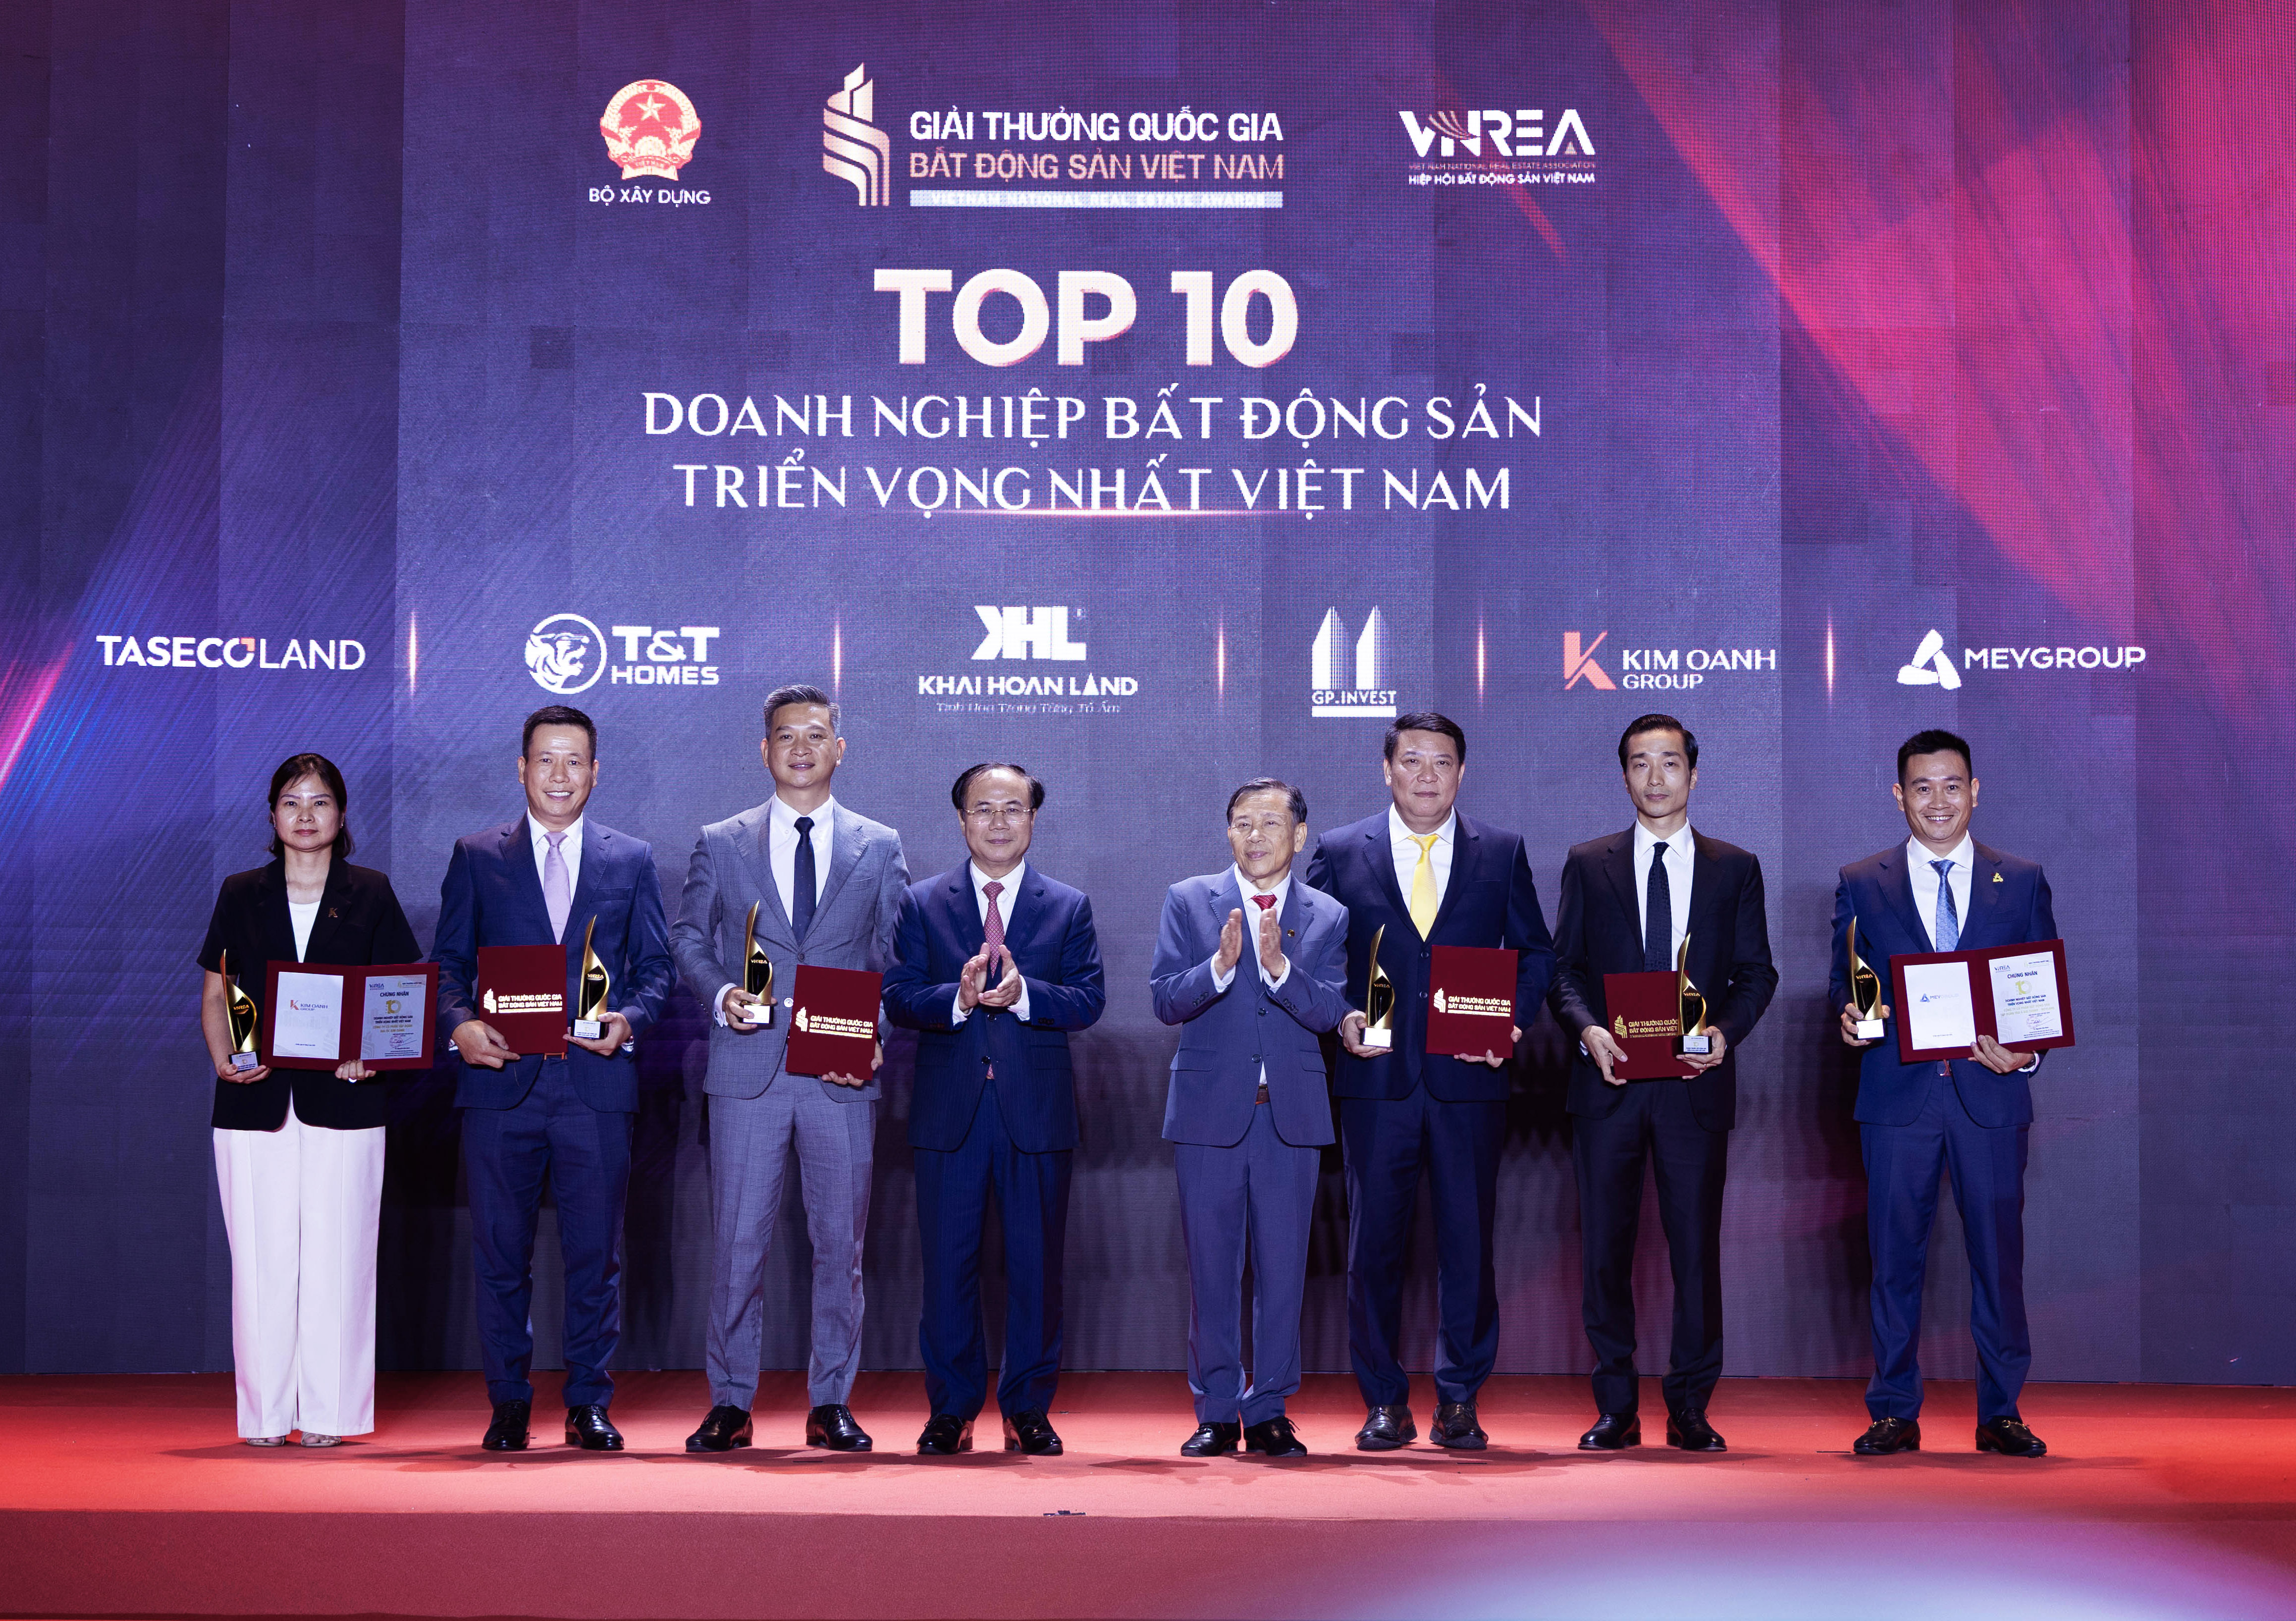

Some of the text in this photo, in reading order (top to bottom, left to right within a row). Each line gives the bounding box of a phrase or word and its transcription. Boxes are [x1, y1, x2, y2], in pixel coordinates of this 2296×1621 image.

[909, 106, 1283, 141] GIẢI THƯỞNG QUỐC GIA
[1398, 109, 1596, 157] VNREA
[910, 147, 1283, 183] BẤT ĐỘNG SẢN VIỆT NAM
[1409, 171, 1595, 186] HIỆP HỘI BẤT ĐỘNG SẢN VIỆT NAM
[589, 185, 711, 207] BỘ XÂY DỰNG
[874, 269, 1299, 368] TOP 10
[641, 382, 1541, 448] DOANH NGHIỆP BẤT ĐỘNG SẢN
[673, 448, 1509, 519] TRIỂN VỌNG NHẤT VIỆT NAM
[612, 626, 720, 662] T&T
[971, 605, 1086, 660] KHL
[1622, 649, 1775, 670] KIM OANH
[1965, 647, 2146, 669] MEYGROUP
[612, 665, 719, 685] HOMES
[918, 672, 1138, 696] KHAI HOAN LAND
[1622, 674, 1704, 690] GROUP
[1312, 691, 1396, 704] GP.INVEST
